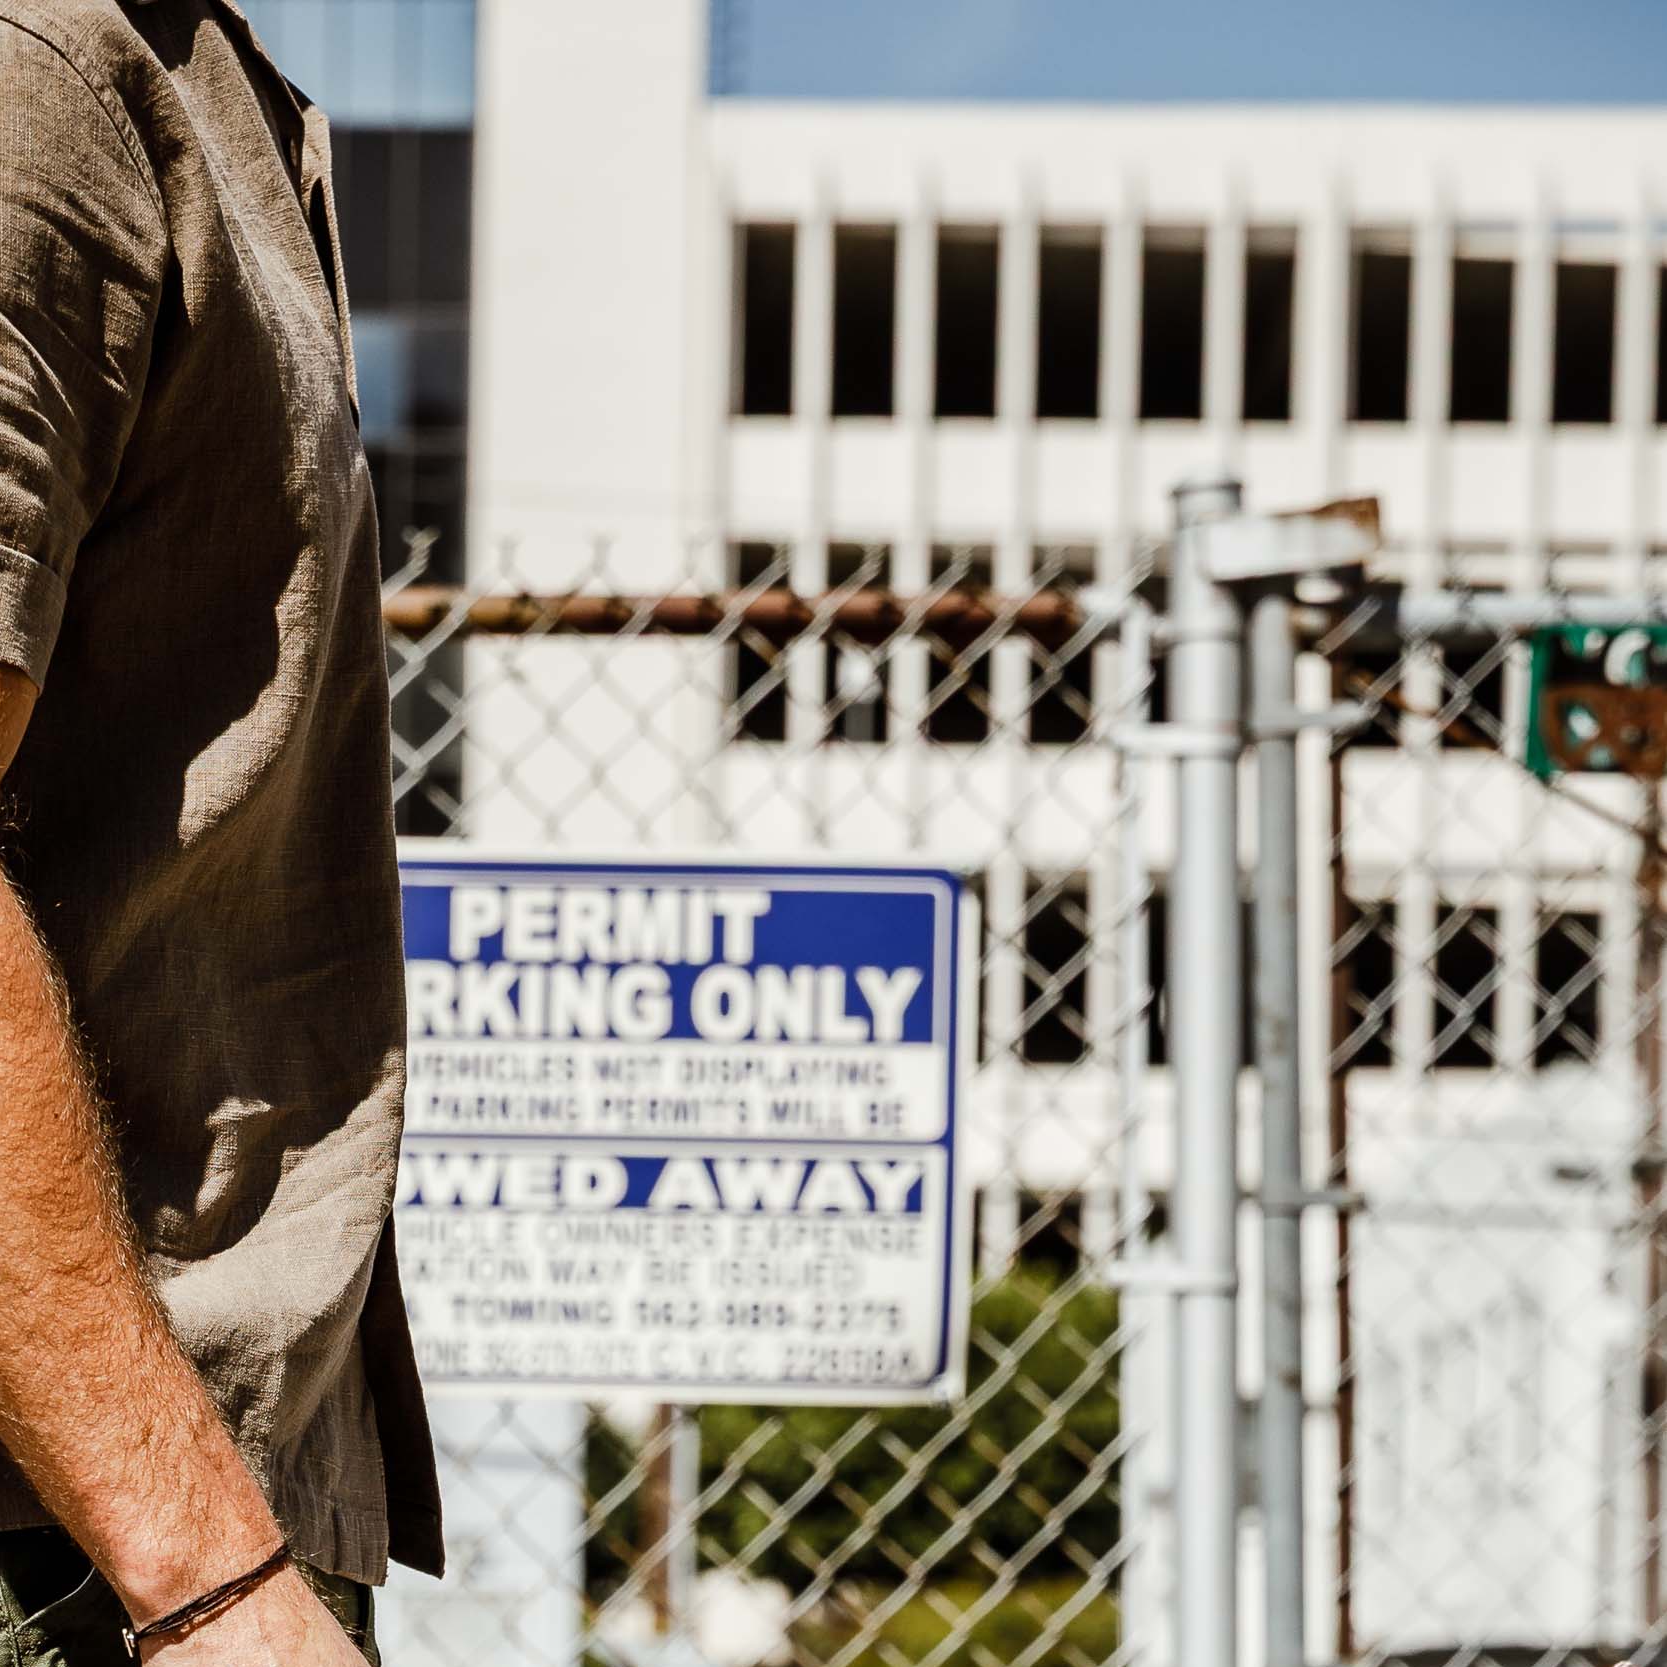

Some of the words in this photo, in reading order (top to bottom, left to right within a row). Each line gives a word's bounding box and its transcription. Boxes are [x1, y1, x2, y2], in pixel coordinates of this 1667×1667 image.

[448, 884, 771, 967] PERMIT
[406, 958, 673, 1042] RKING
[689, 962, 924, 1044] ONLY
[594, 1052, 665, 1087] NOT
[679, 1053, 892, 1090] DISPLAYING
[427, 1091, 581, 1126] PARKING
[598, 1093, 751, 1128] PERMITS
[768, 1095, 846, 1130] WILL
[865, 1097, 908, 1130] BE
[645, 1156, 926, 1213] AWAY
[736, 1220, 924, 1255] EXPENSE
[715, 1257, 863, 1292] ISSUED
[448, 1293, 616, 1330] TOWING
